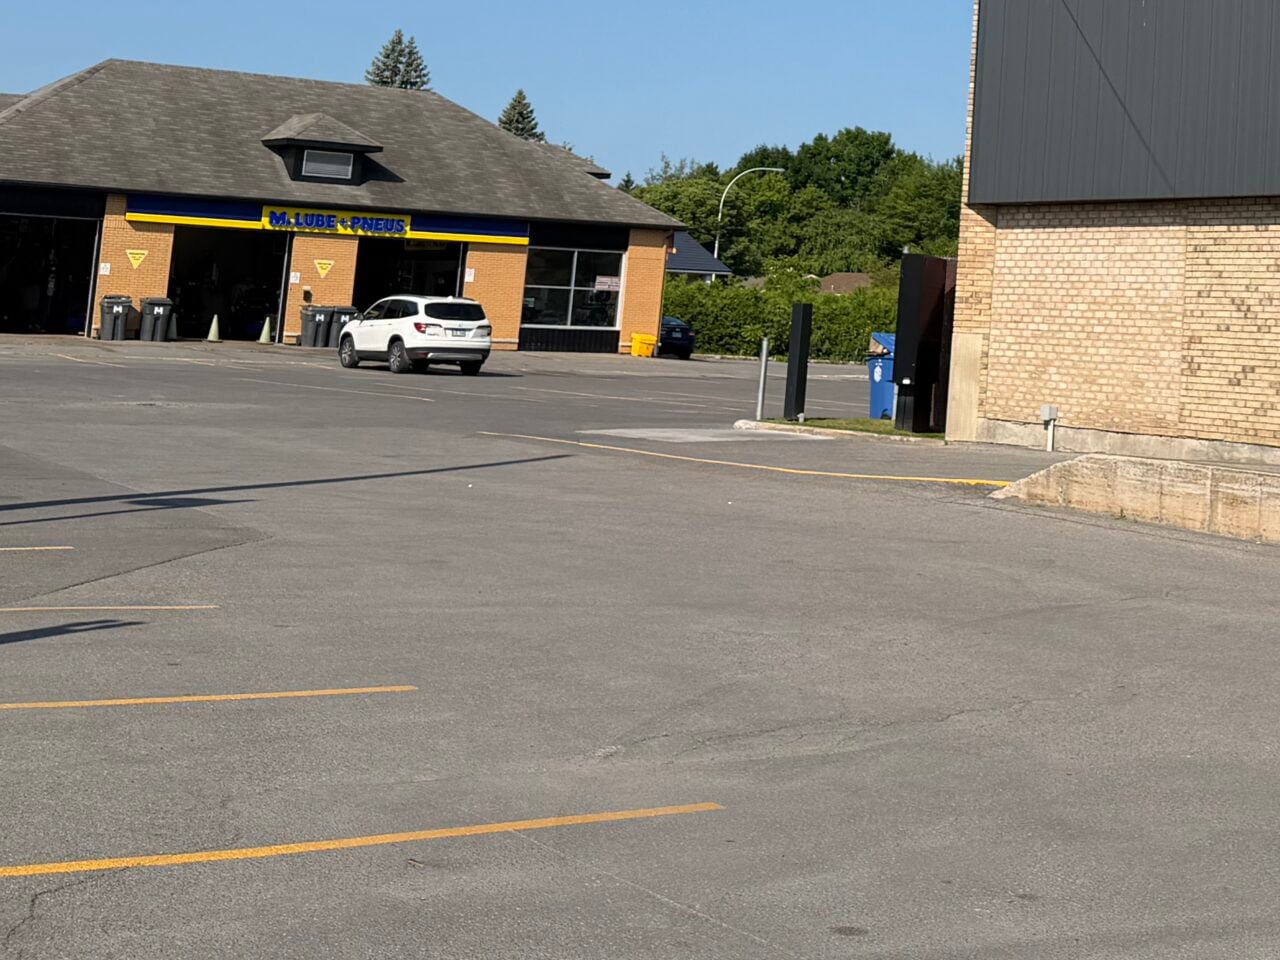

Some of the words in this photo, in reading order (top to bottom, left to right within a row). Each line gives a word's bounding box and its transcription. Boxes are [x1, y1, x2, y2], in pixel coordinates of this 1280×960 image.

[268, 210, 291, 227] M.
[294, 212, 338, 230] LUBE
[350, 215, 406, 233] PNEUS
